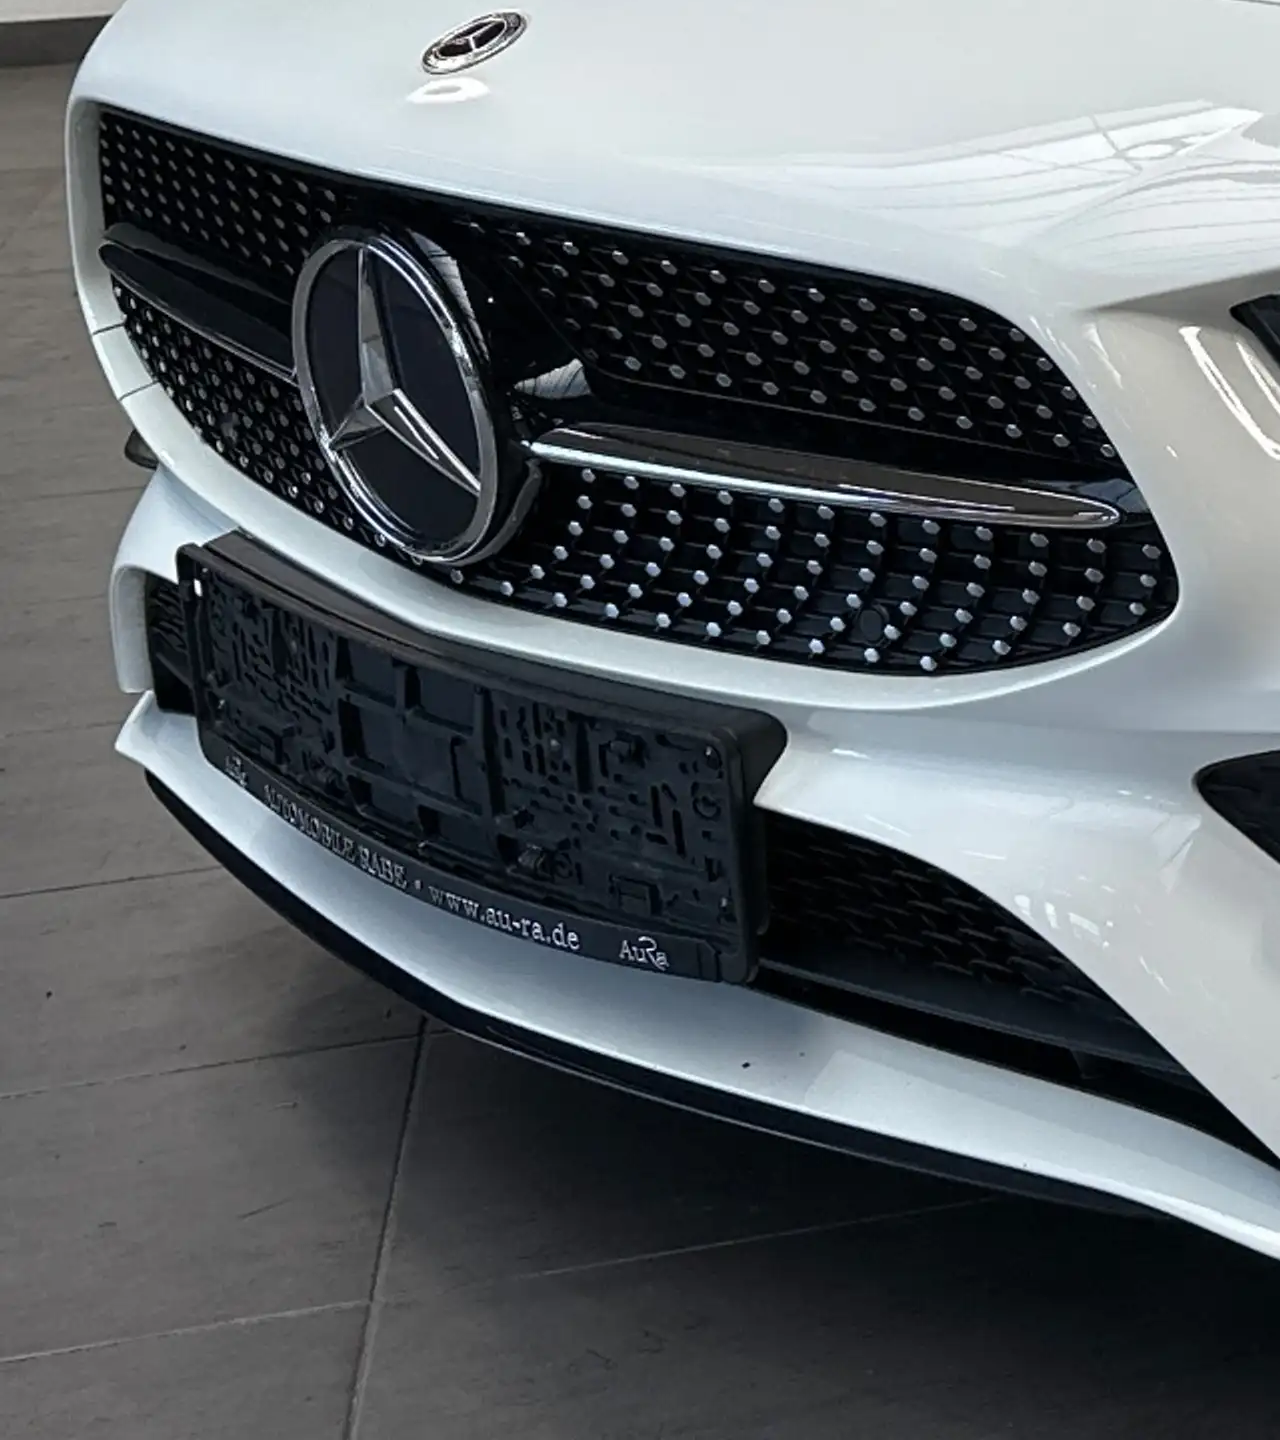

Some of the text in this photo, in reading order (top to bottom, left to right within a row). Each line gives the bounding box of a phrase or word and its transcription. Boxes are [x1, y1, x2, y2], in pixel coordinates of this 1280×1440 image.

[357, 845, 408, 889] RABE
[428, 885, 581, 951] www.au-ra.de
[618, 935, 670, 971] AuRa
